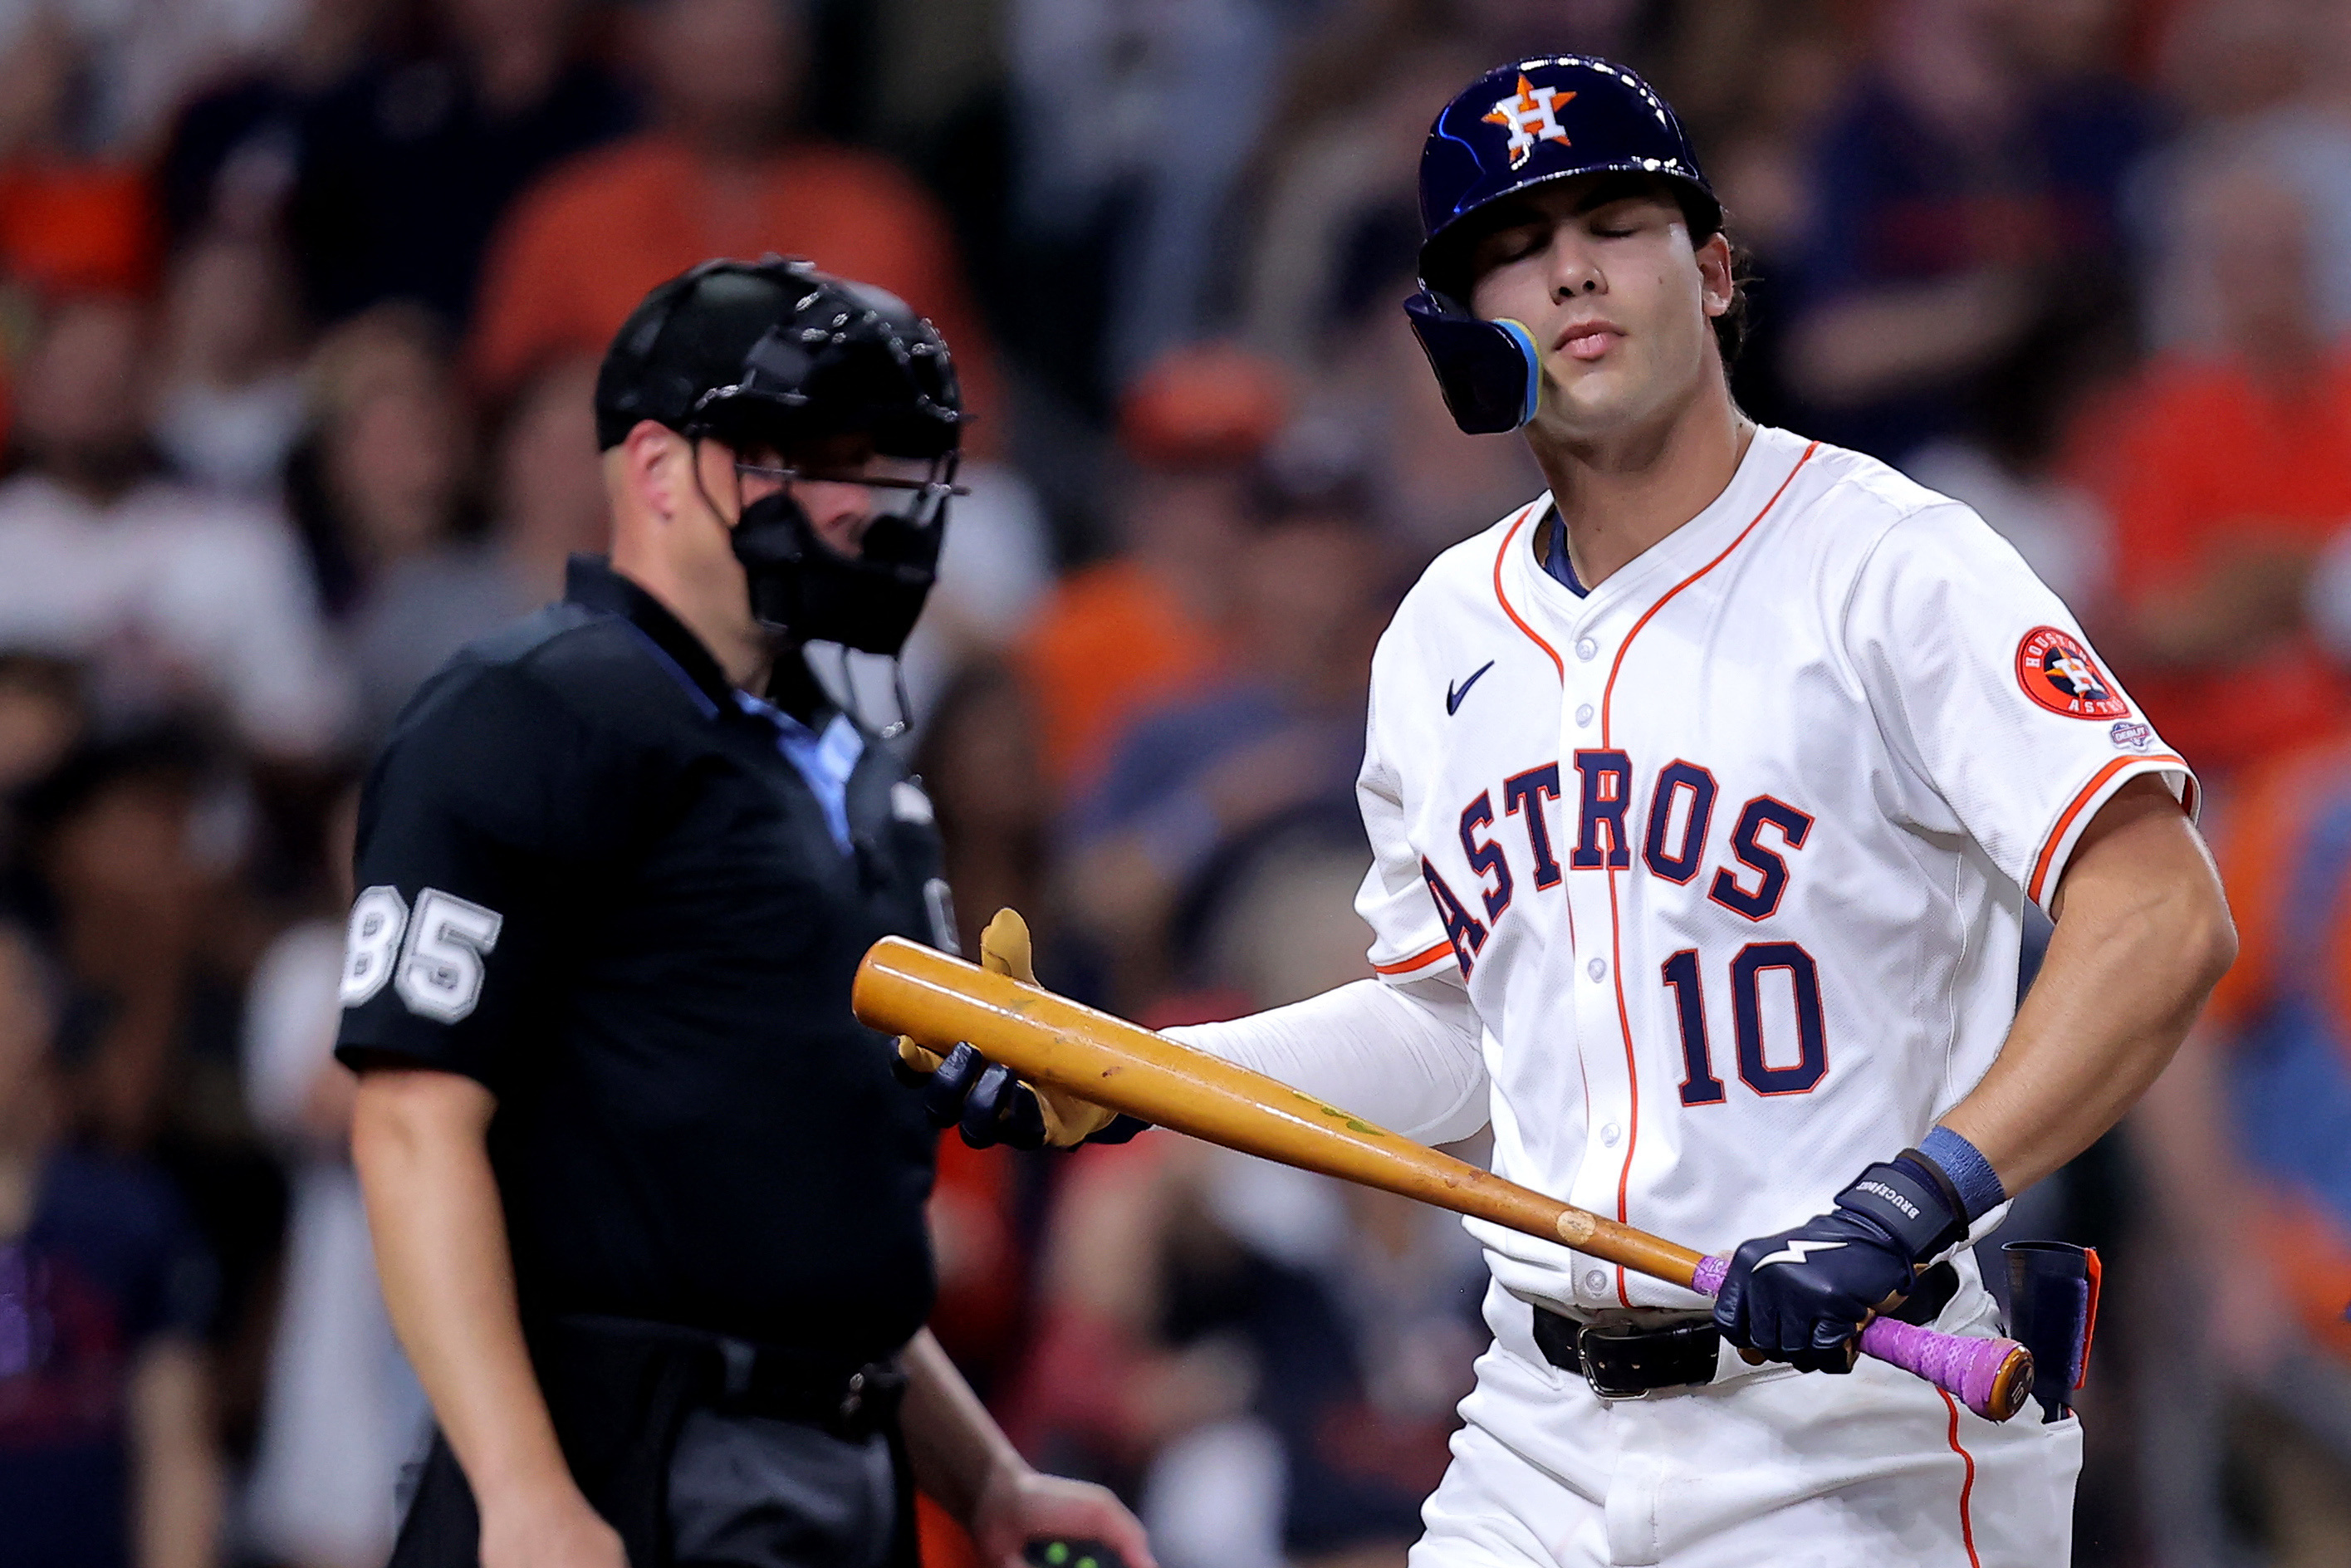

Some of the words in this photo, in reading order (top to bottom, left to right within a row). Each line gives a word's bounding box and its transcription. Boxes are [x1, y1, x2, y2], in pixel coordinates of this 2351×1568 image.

[1494, 86, 1569, 151] H
[2025, 632, 2088, 669] HOUSTON
[1421, 748, 1815, 984] ASTROS
[339, 884, 504, 1026] 85
[1661, 940, 1829, 1107] 10
